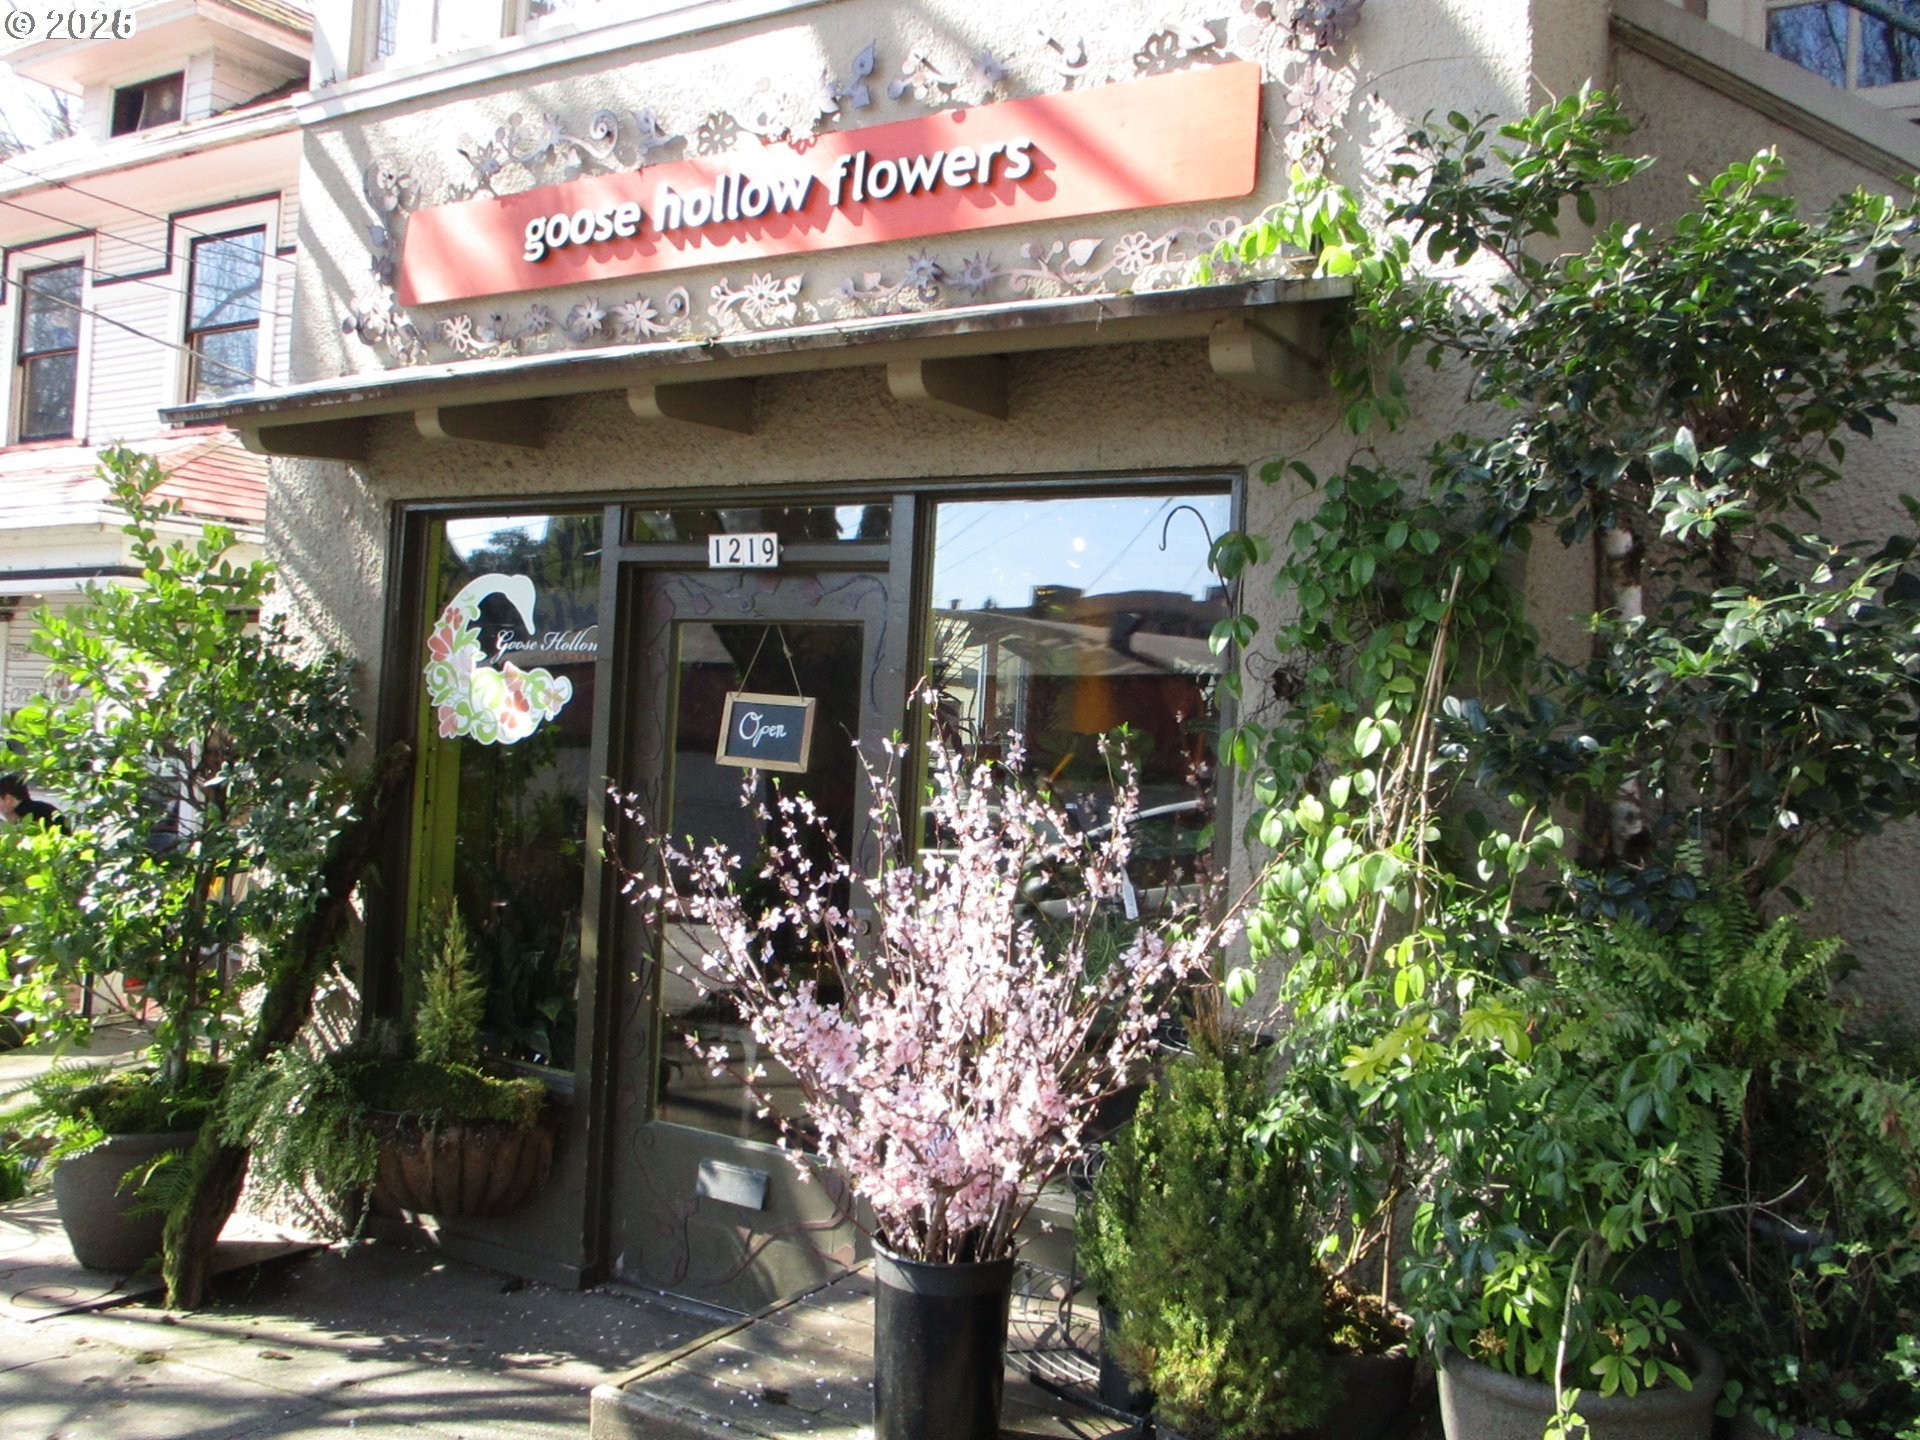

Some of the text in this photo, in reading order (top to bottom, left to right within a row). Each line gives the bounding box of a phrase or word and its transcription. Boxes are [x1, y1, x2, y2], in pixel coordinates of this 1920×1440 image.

[522, 137, 1033, 262] goose hollow flowers
[715, 537, 774, 564] 1219
[490, 629, 537, 664] Goose
[739, 711, 787, 748] Open
